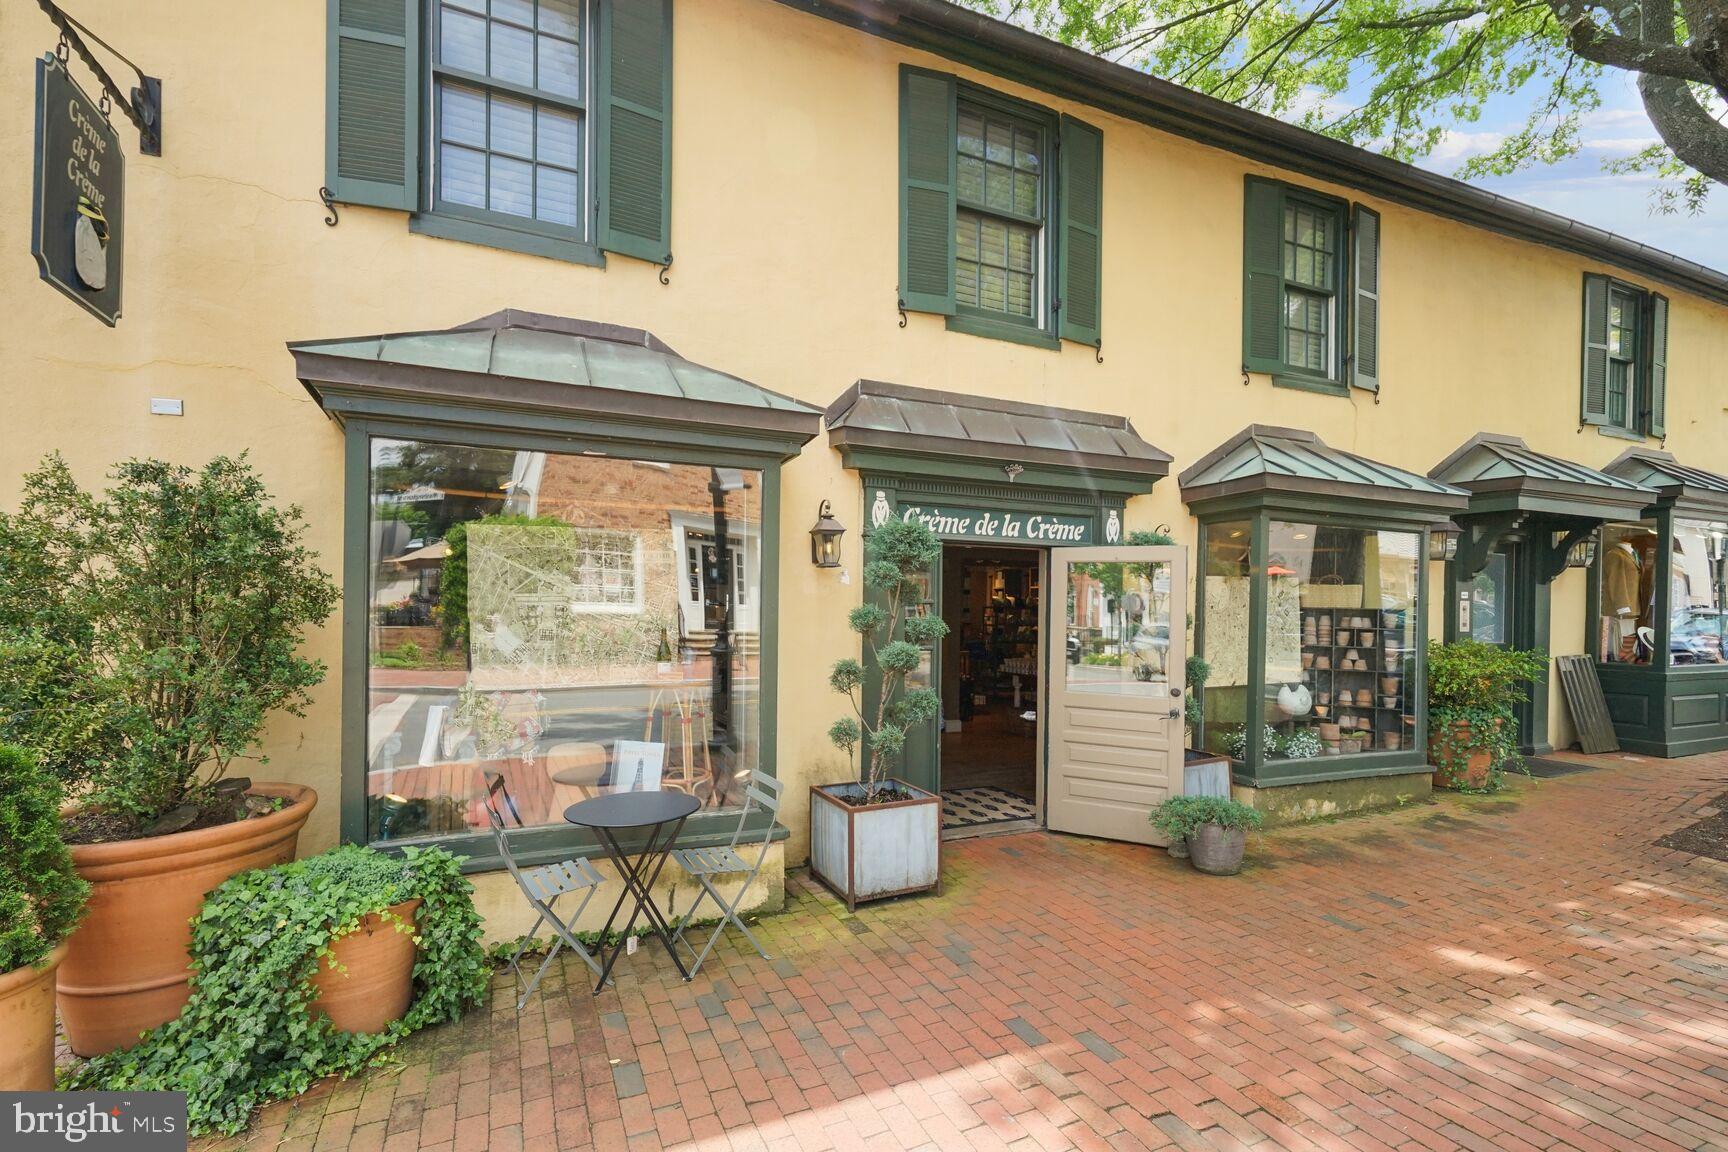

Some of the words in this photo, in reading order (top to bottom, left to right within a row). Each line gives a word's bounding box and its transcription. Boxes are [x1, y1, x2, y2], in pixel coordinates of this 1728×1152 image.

[69, 100, 106, 154] Crème
[72, 136, 88, 161] de
[88, 149, 100, 176] la
[67, 158, 106, 208] Crème
[974, 512, 999, 536] de
[1002, 513, 1021, 538] la
[1026, 516, 1085, 541] Crème
